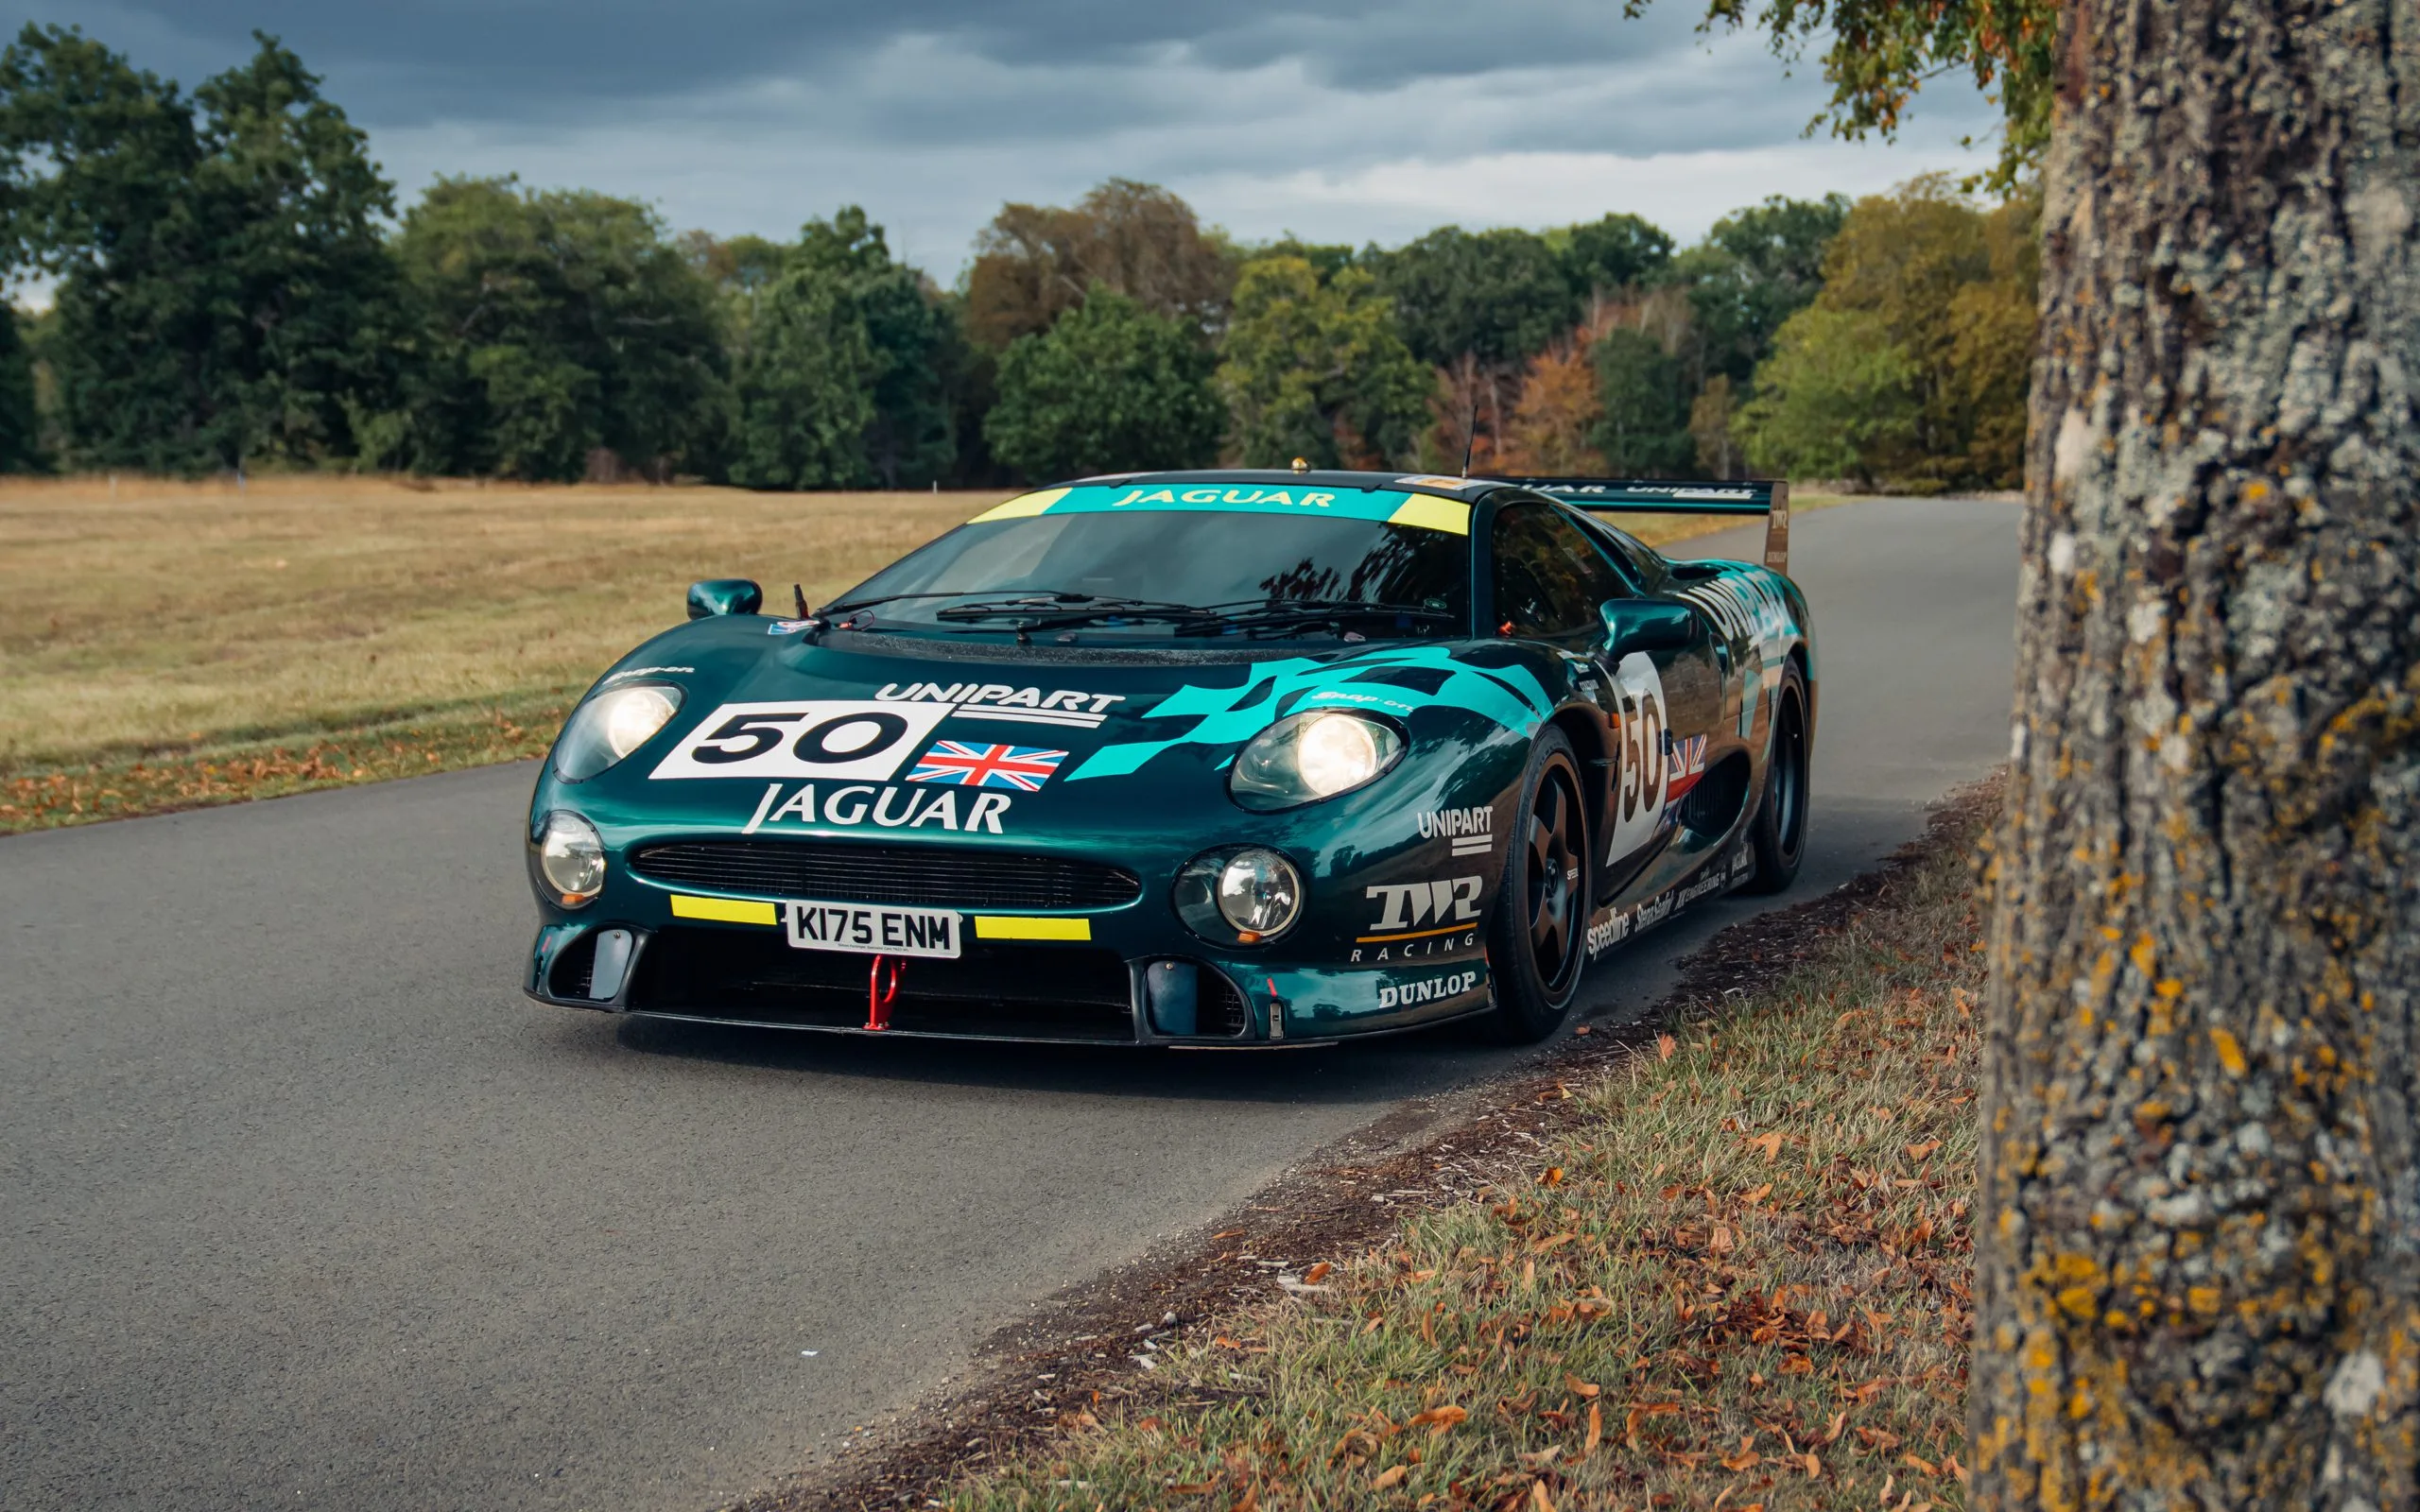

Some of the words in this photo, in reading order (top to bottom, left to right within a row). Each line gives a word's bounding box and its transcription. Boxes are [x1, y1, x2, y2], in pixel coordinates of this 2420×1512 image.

[1112, 489, 1336, 507] JAGUAR
[874, 682, 1126, 713] UNIPART
[691, 712, 908, 765] 50
[1623, 688, 1661, 823] 50
[741, 782, 1011, 834] JAGUAR
[1418, 805, 1494, 839] UNIPART
[1366, 875, 1483, 931] TWR
[796, 906, 873, 944] K175
[881, 913, 951, 951] ENM
[1350, 933, 1474, 962] RACING
[1378, 971, 1477, 1008] DUNLOP
